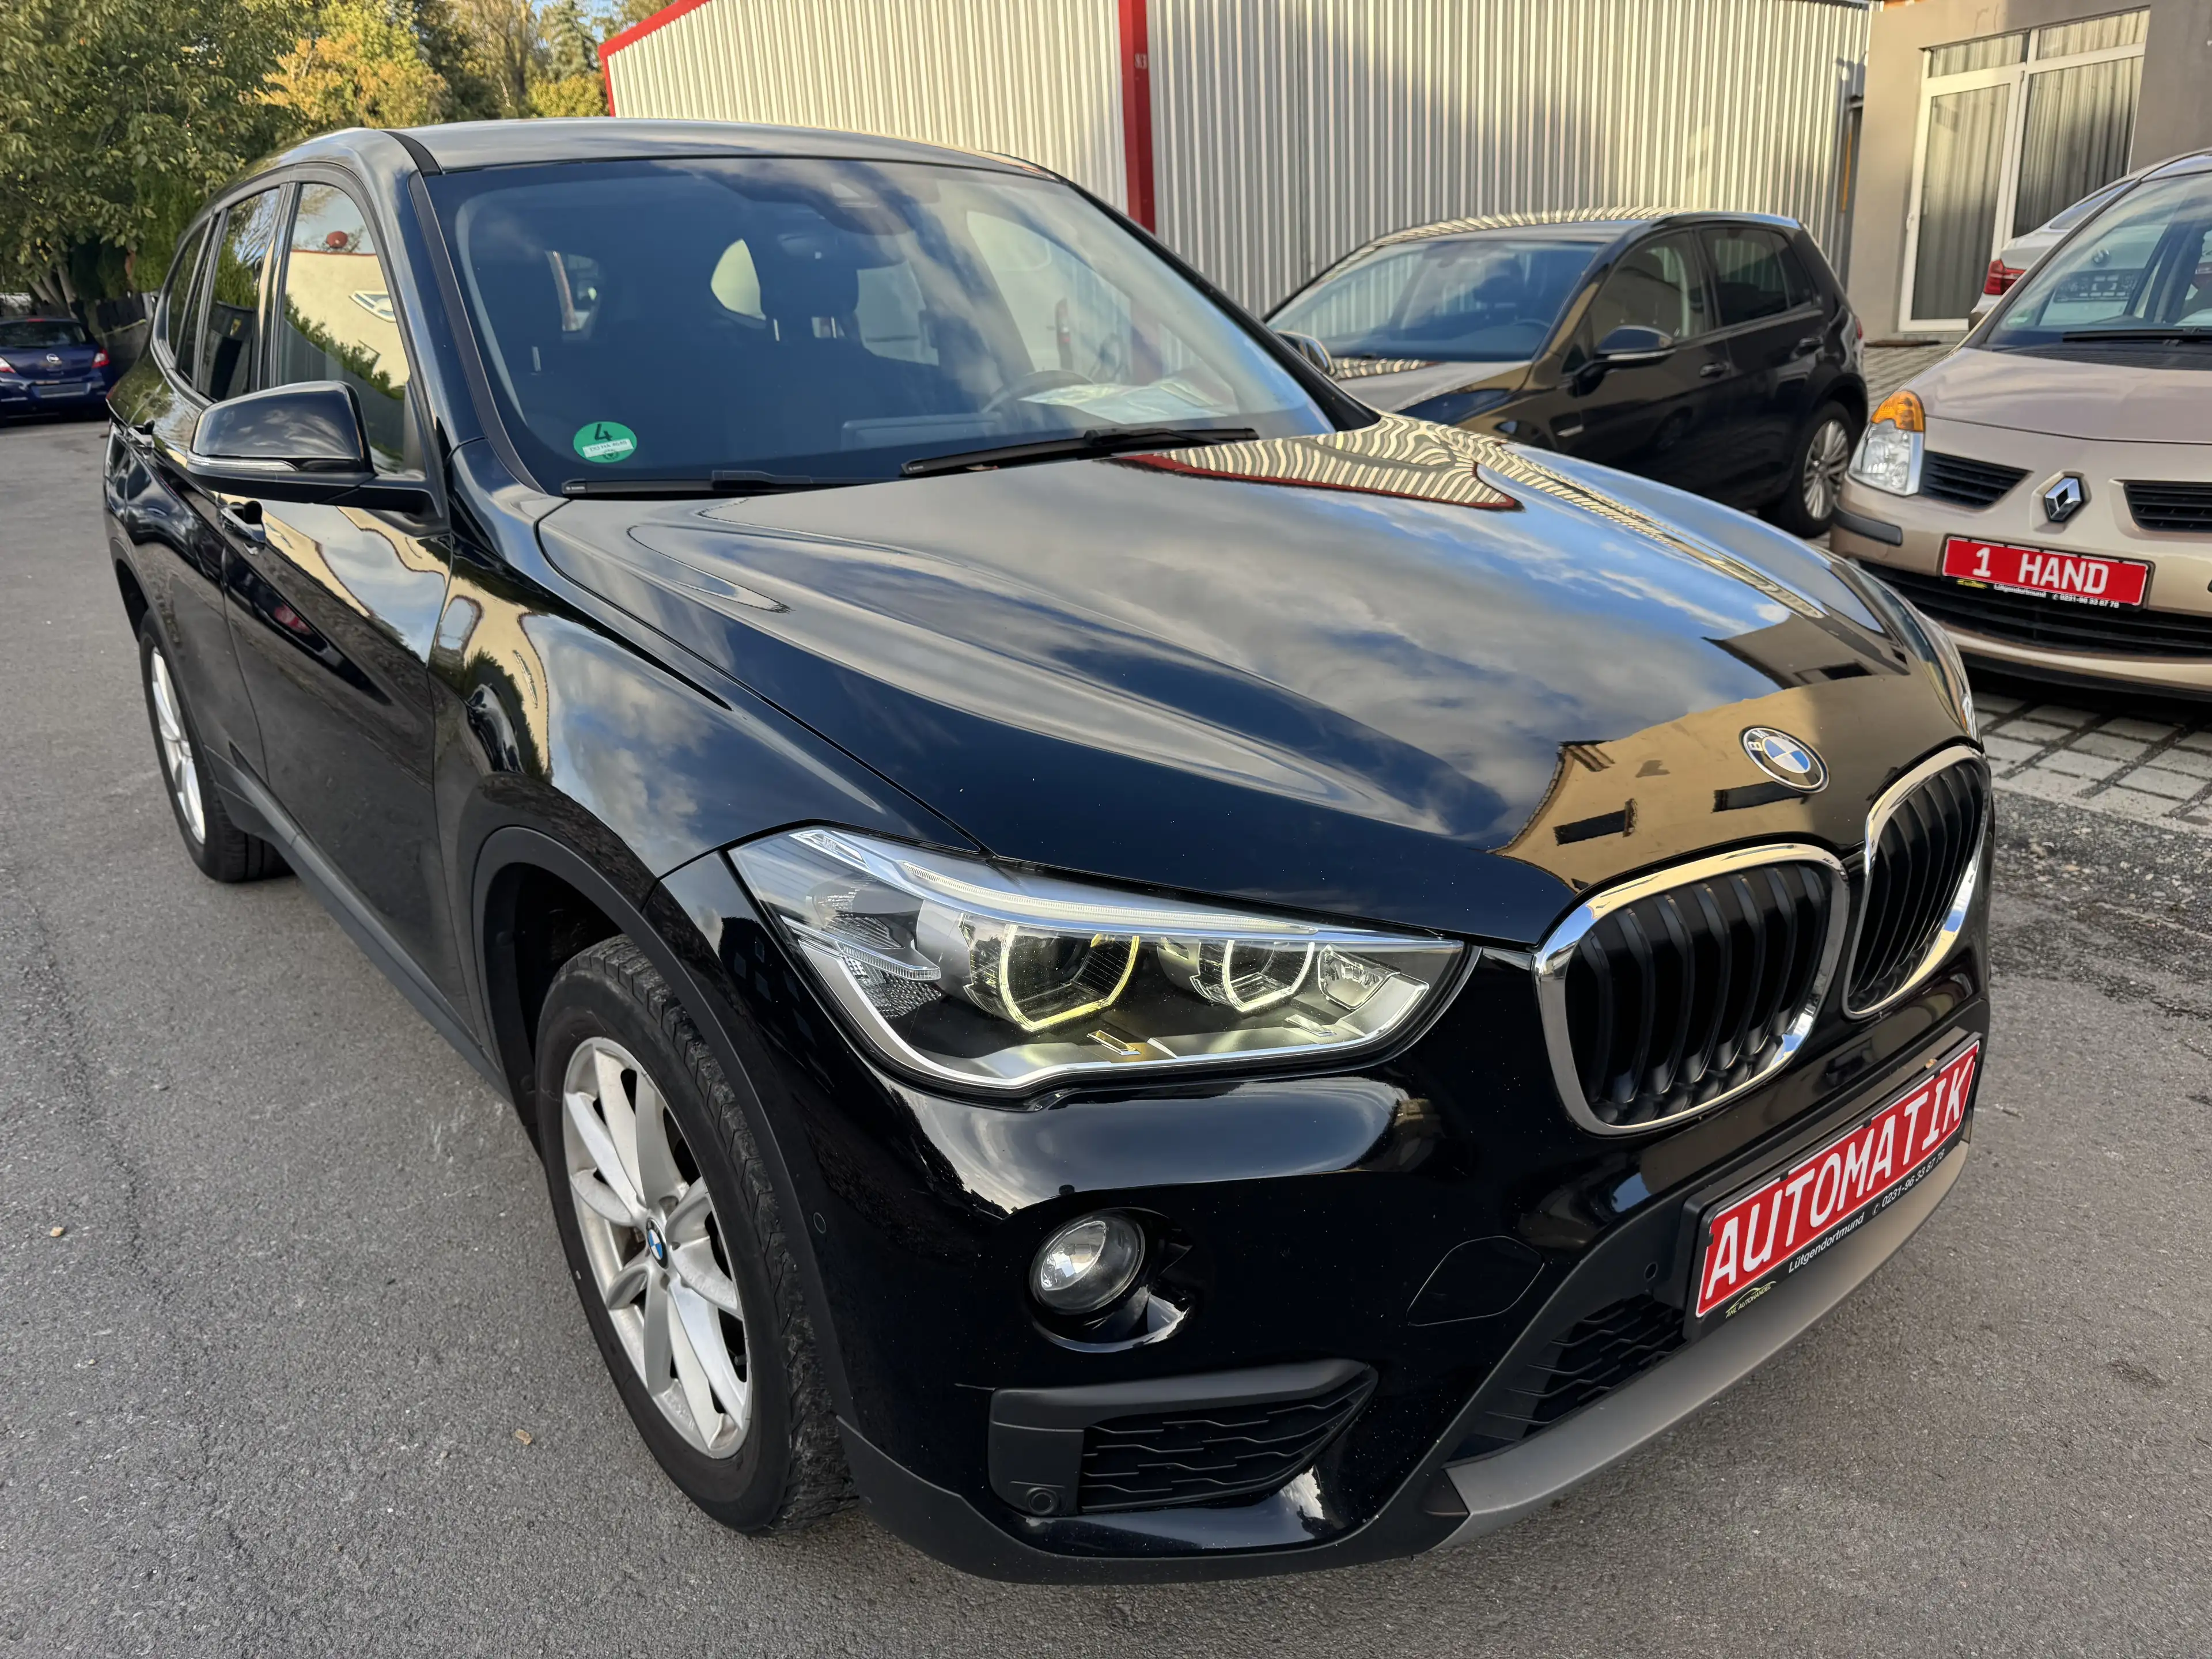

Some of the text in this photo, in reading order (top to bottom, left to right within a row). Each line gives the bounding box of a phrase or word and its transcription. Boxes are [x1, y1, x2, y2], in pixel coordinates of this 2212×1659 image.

[594, 423, 612, 441] 4
[1972, 548, 2109, 594] 1 HAND
[1705, 1056, 1974, 1300] AUTOMATIK
[1789, 1148, 1945, 1273] Lütgendortmund 0231-96 33 87 78
[1725, 1283, 1771, 1319] AHL AUTOHANDEL
